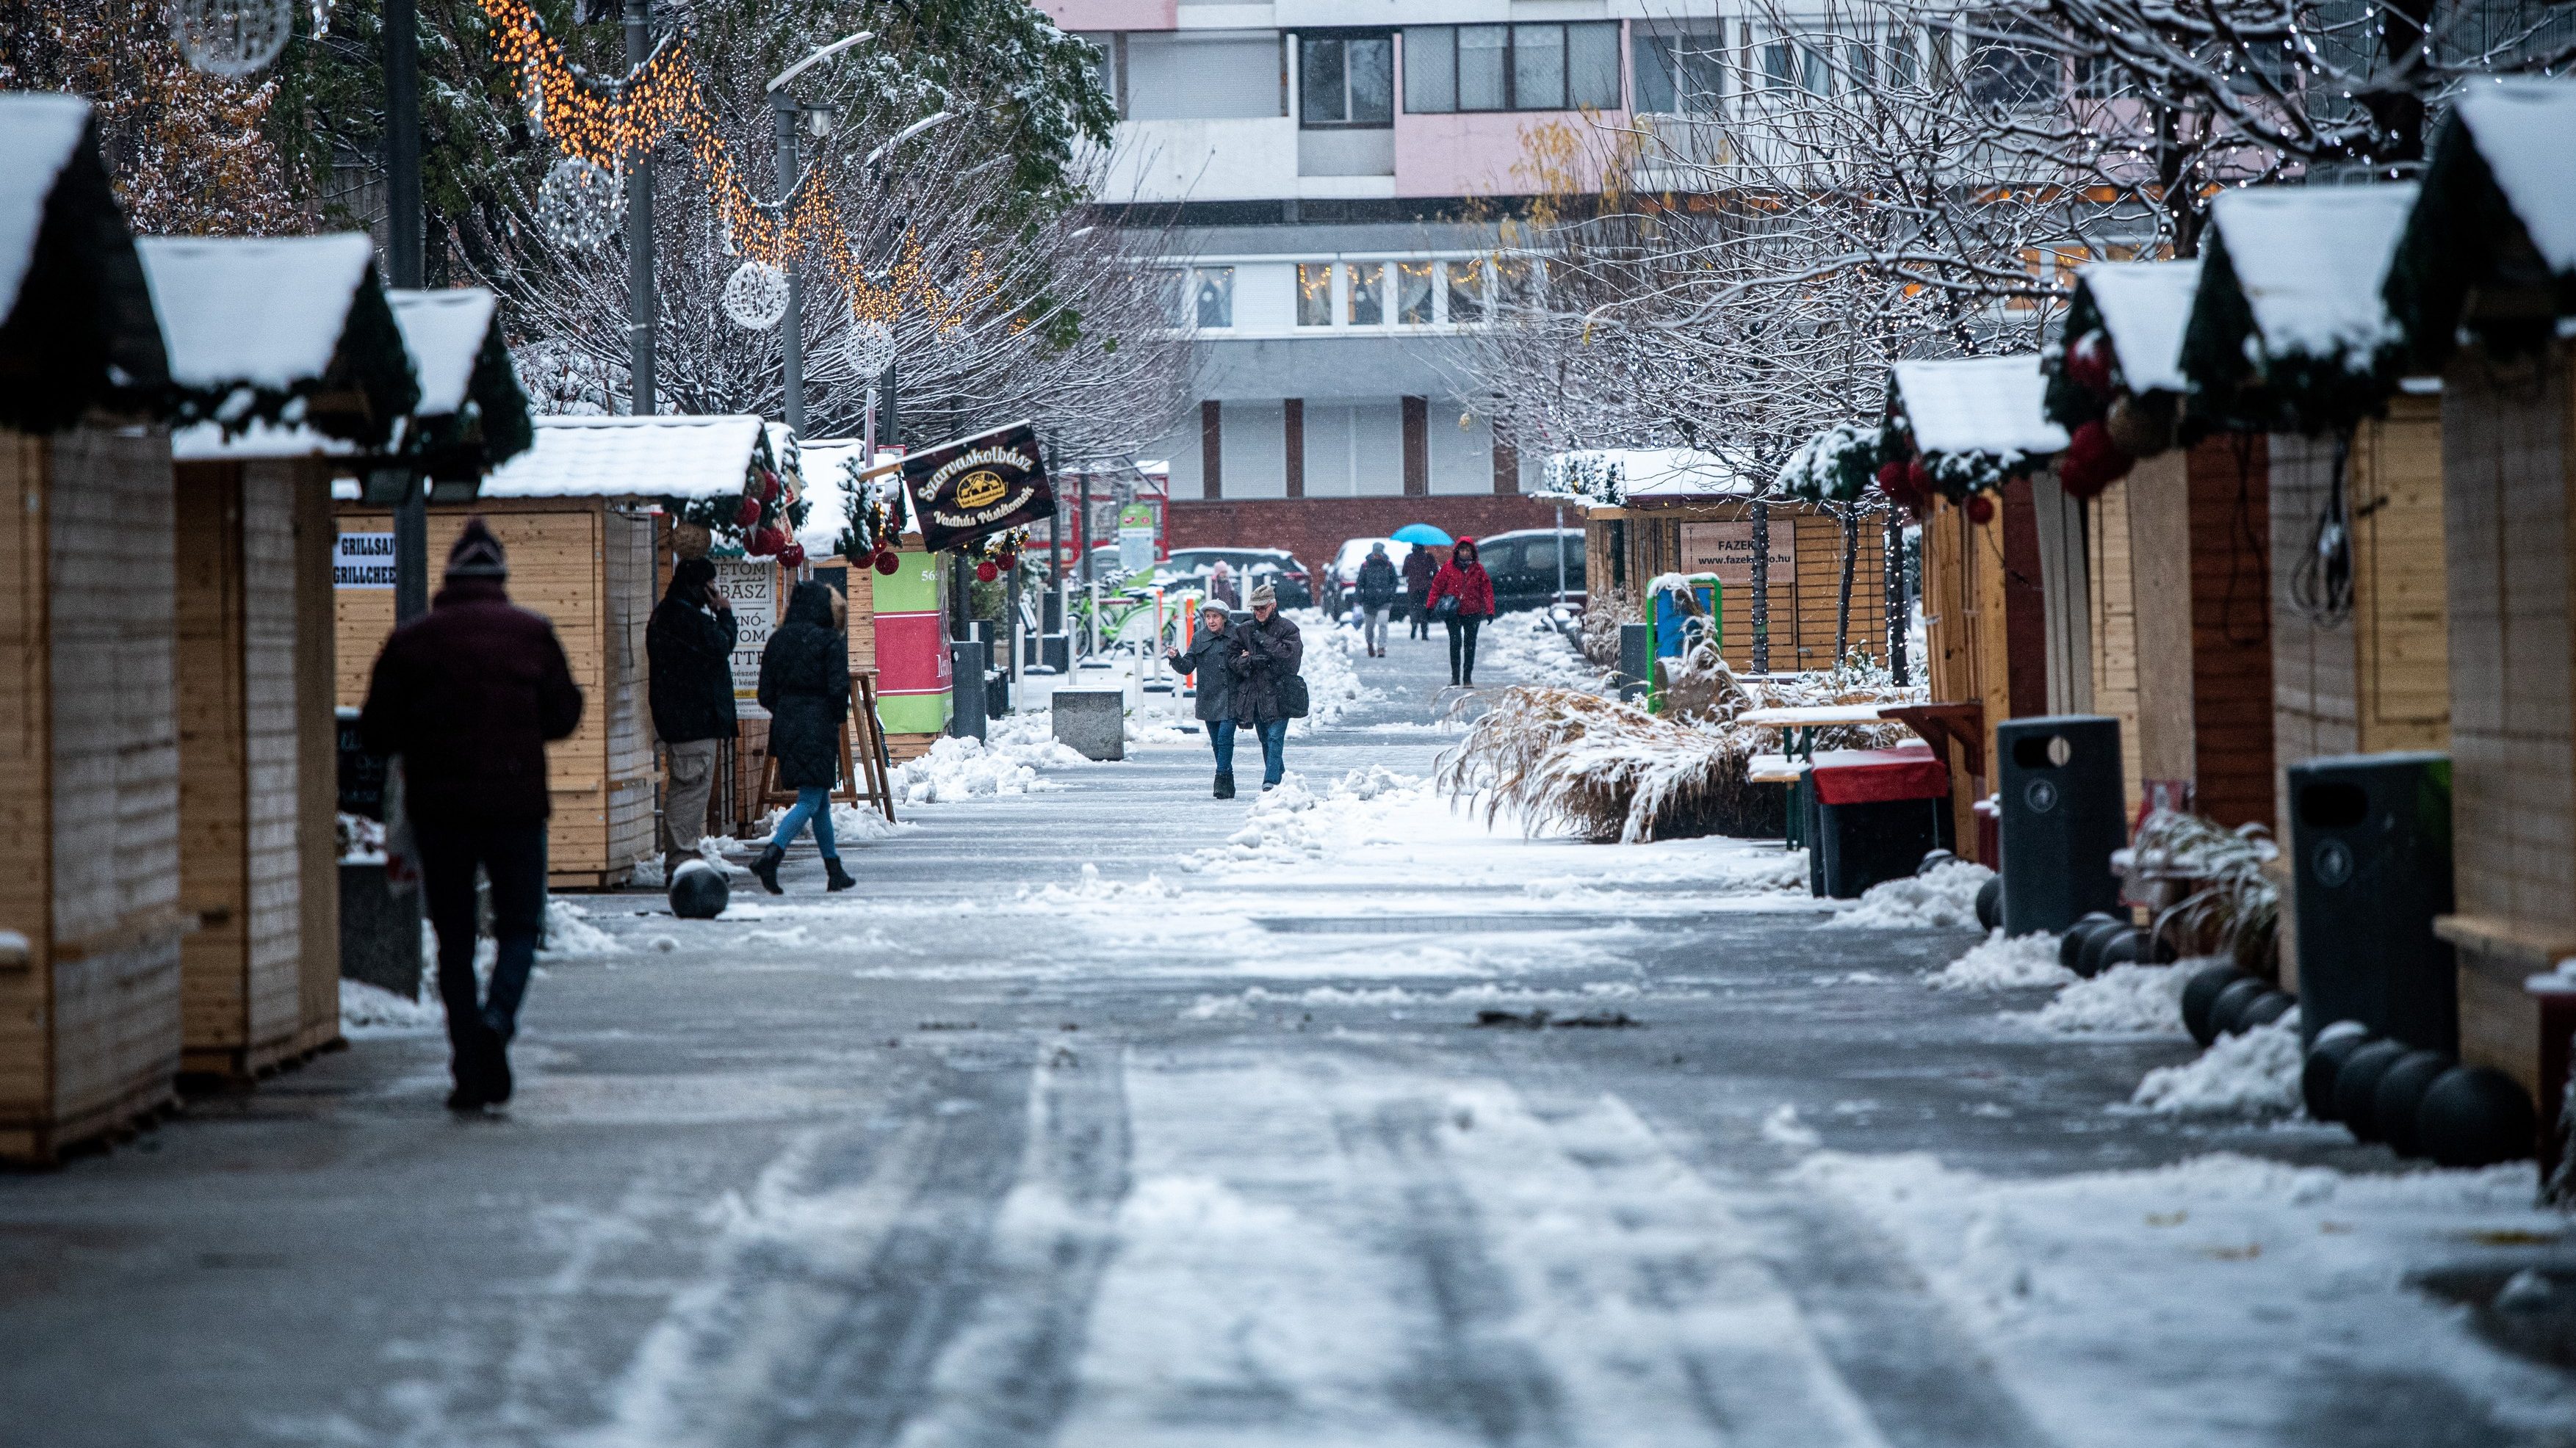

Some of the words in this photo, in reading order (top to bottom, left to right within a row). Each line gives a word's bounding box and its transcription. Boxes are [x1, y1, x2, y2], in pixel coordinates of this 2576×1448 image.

[917, 446, 1035, 502] Szarvaskolbász
[934, 510, 977, 527] Vadhús
[977, 485, 1034, 524] Pástétomok
[342, 537, 393, 556] GRILLSAJ
[1698, 554, 1791, 565] www.fazeko.hu
[737, 629, 766, 642] OM
